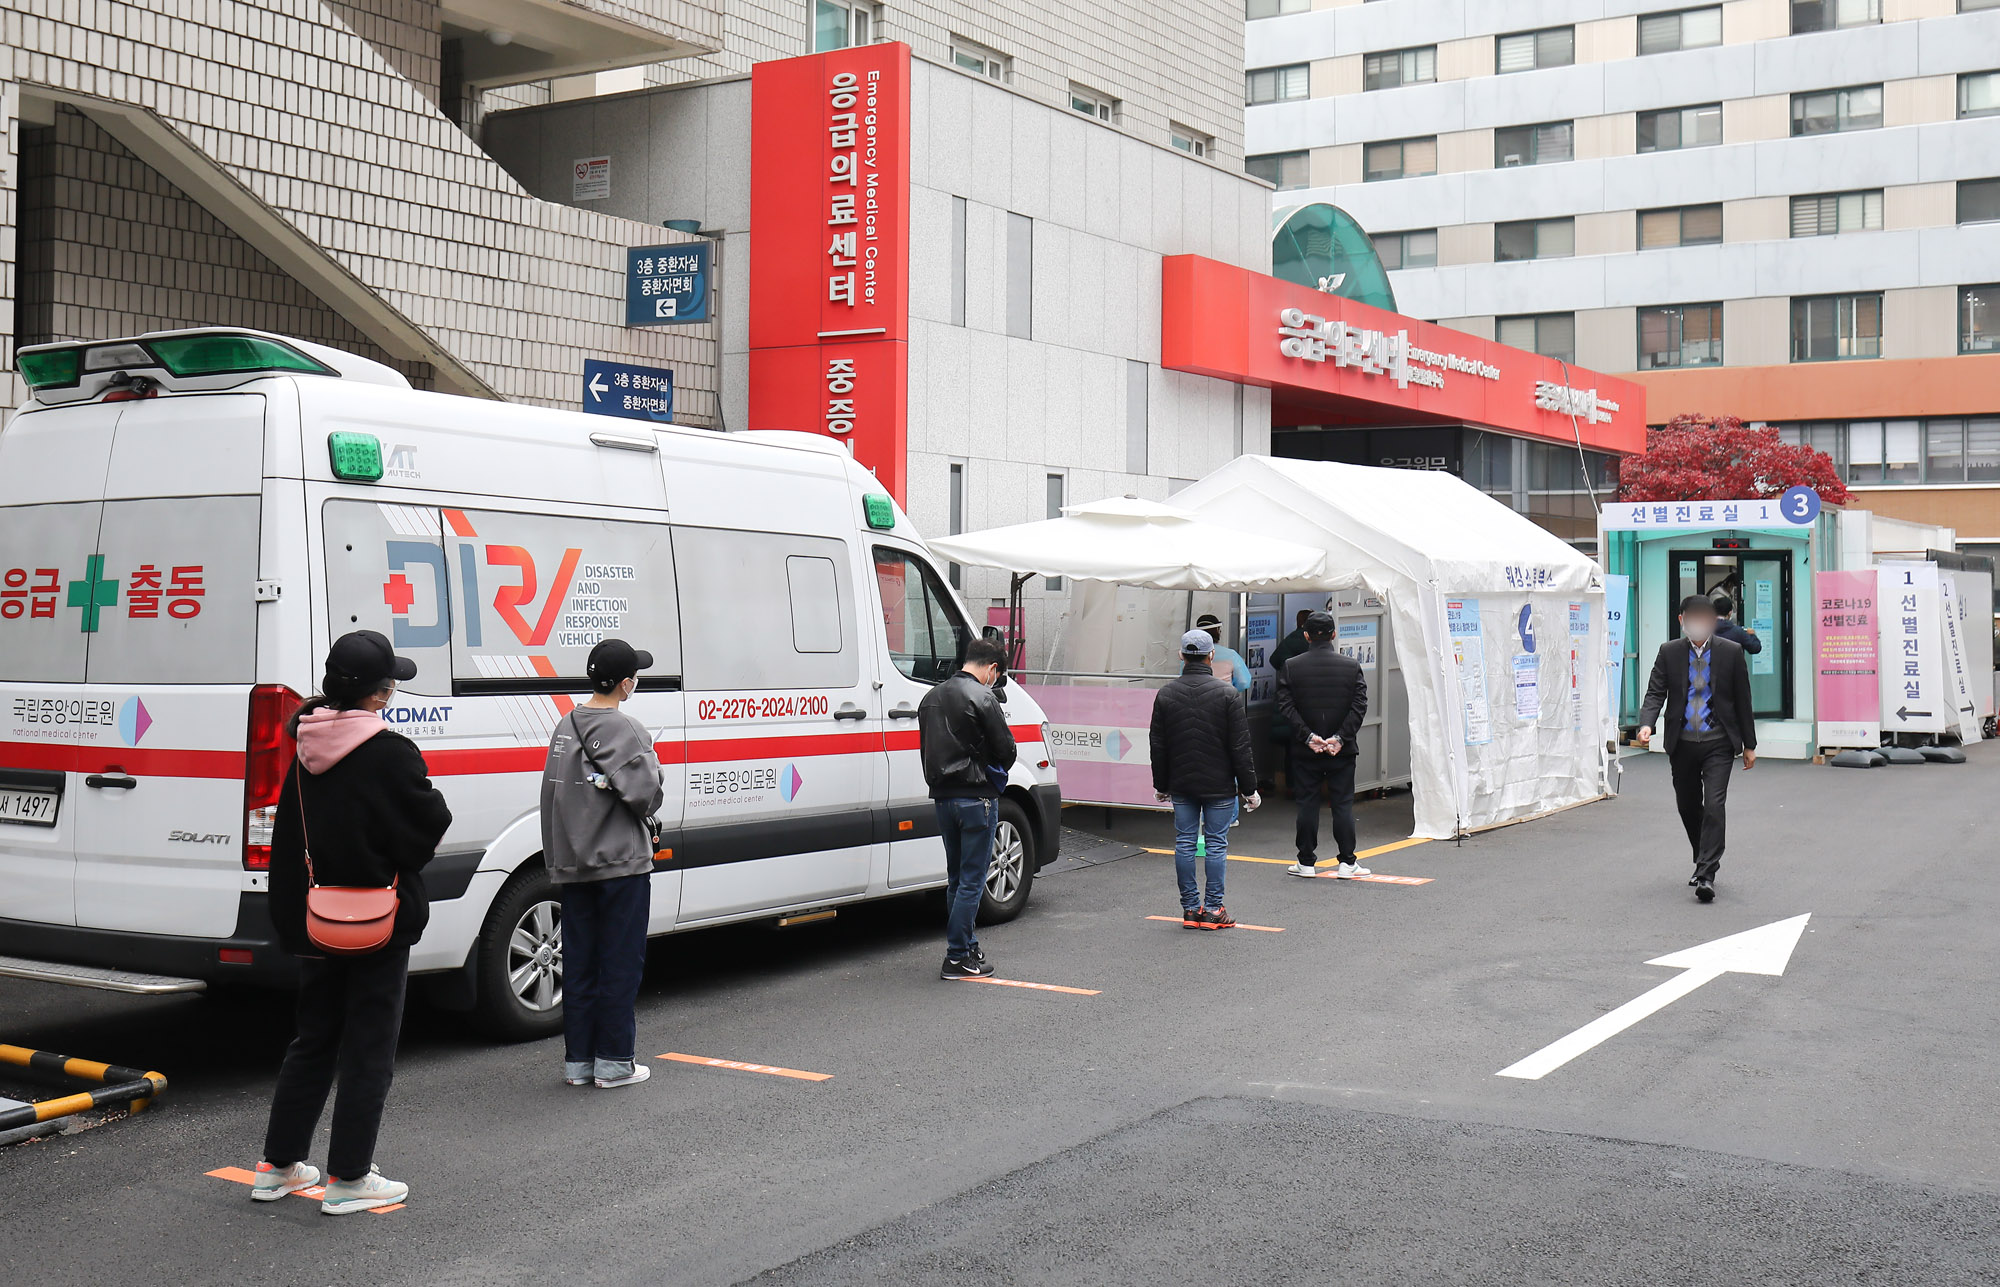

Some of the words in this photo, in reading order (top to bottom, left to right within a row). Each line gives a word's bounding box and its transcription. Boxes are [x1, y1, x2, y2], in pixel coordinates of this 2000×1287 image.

[864, 70, 880, 168] Emergency
[828, 72, 859, 307] 응급의료센터
[865, 173, 879, 241] Medical
[637, 257, 654, 275] 3층
[657, 254, 699, 274] 중환자실
[865, 246, 879, 305] Center
[641, 276, 693, 296] 중환자면회
[1278, 308, 1408, 390] 응급의료센터
[1407, 342, 1448, 371] Emergency
[1448, 353, 1477, 375] Medical
[1477, 360, 1500, 381] Center
[614, 372, 629, 388] 3층
[632, 374, 668, 393] 중환자실
[622, 394, 668, 414] 중환자면회
[826, 358, 857, 458] 중증
[387, 469, 421, 479] AUTECH
[1631, 504, 1738, 524] 선별진료실
[1759, 505, 1769, 520] 1
[1792, 494, 1809, 517] 3
[585, 565, 635, 579] DISASTER
[1903, 571, 1914, 585] 1
[0, 568, 61, 619] 응급
[126, 564, 206, 619] 출동
[386, 540, 583, 649] DIRV
[577, 582, 601, 595] AND
[1942, 583, 1948, 597] 2
[572, 599, 628, 612] INFECTION
[1821, 598, 1872, 610] 코로나19
[565, 616, 619, 629] RESPONSE
[1822, 614, 1868, 627] 선별진료
[559, 632, 603, 646] VEHICLE
[1901, 594, 1921, 700] 선별진료실
[13, 698, 115, 726] 국립중앙의료원
[382, 706, 453, 723] KDMAT
[698, 695, 828, 721] 02-2276-2024/2100
[12, 728, 41, 738] national
[41, 729, 71, 739] medical
[72, 730, 98, 740] center
[1051, 730, 1102, 748] 앙의료원
[689, 768, 777, 795] 국립중앙의료원
[16, 795, 50, 818] 1497
[688, 797, 717, 808] national
[717, 795, 743, 805] medical
[743, 794, 764, 804] center
[168, 830, 231, 845] SOLATI
